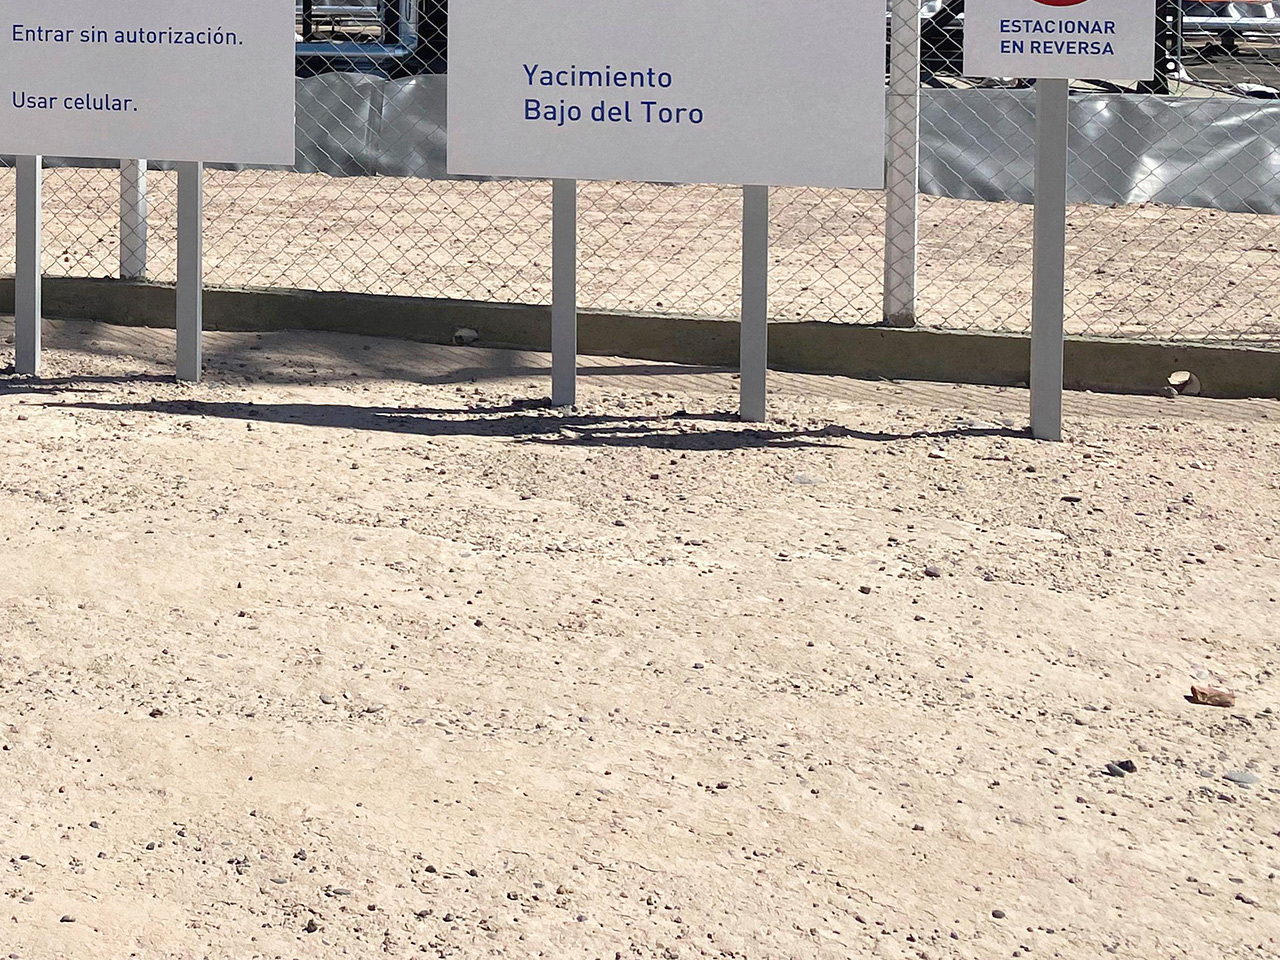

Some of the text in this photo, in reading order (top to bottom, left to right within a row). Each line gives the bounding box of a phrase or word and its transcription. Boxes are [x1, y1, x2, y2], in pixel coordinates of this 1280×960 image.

[12, 24, 243, 45] Entrar sin autorización.
[1000, 19, 1116, 35] ESTACIONAR
[1000, 40, 1115, 56] EN REVERSA
[522, 64, 672, 88] Yacimiento
[12, 91, 138, 112] Usar celular.
[524, 98, 703, 127] Bajo del Toro
